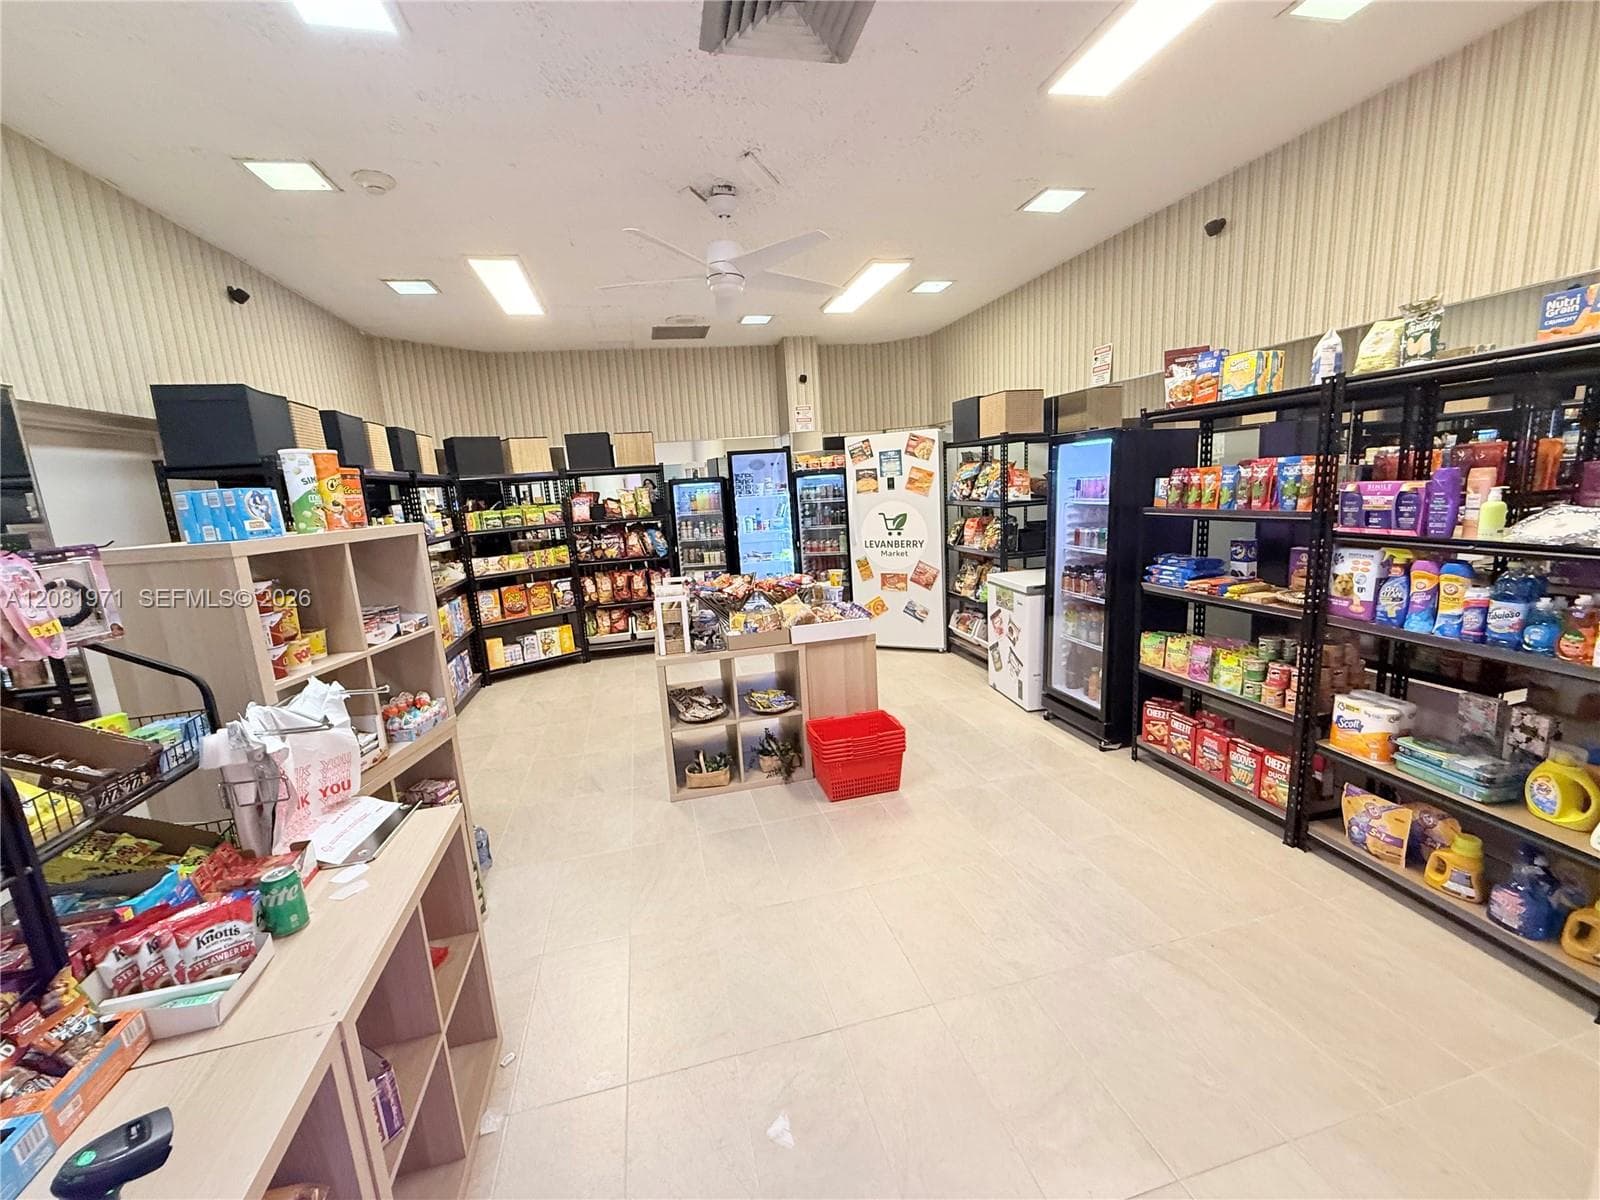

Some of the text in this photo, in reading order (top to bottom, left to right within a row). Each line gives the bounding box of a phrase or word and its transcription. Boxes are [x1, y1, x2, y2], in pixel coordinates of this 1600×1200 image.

[1546, 293, 1581, 310] Nutri
[1545, 304, 1580, 318] Grain
[864, 540, 924, 549] LEVANBERRY
[881, 549, 908, 557] Market
[1146, 708, 1170, 719] CHEEZ-I
[1338, 715, 1362, 729] Scott
[1230, 751, 1257, 768] GROOVES
[1264, 755, 1290, 775] CHEEZ-I
[319, 779, 352, 798] YOU
[262, 884, 299, 907] rite
[195, 925, 241, 950] Knott's
[193, 943, 250, 971] STRAWBERRY
